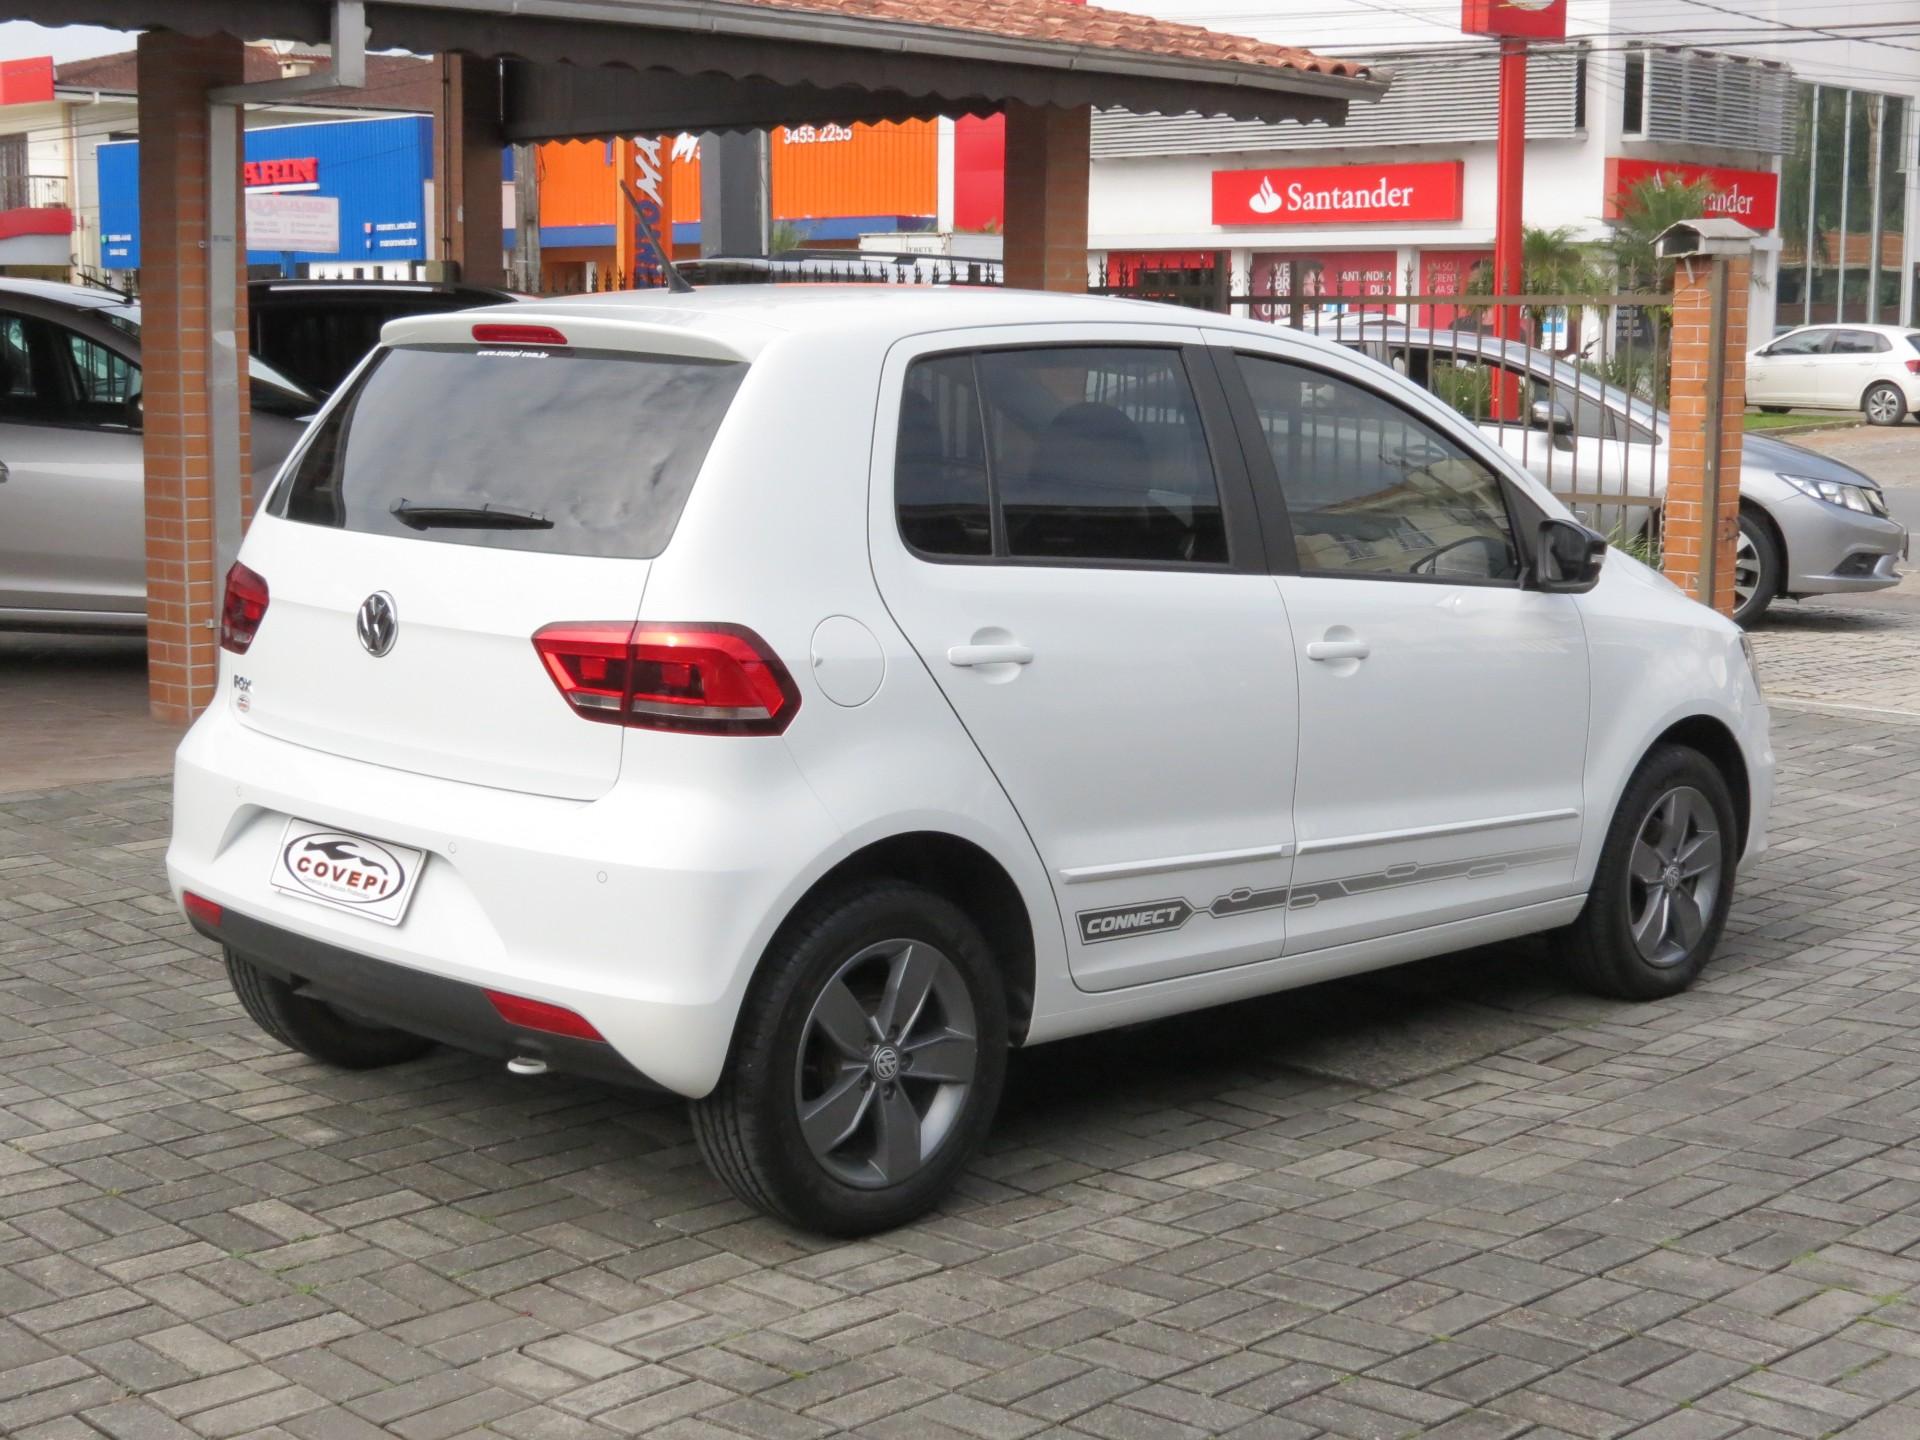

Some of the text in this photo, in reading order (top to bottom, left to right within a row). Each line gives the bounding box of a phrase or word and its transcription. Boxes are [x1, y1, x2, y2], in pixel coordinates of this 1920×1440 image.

[784, 123, 853, 144] 3455.2255
[1287, 176, 1414, 212] Santander
[296, 856, 389, 895] COVEPI
[1086, 906, 1181, 934] CONNECT
